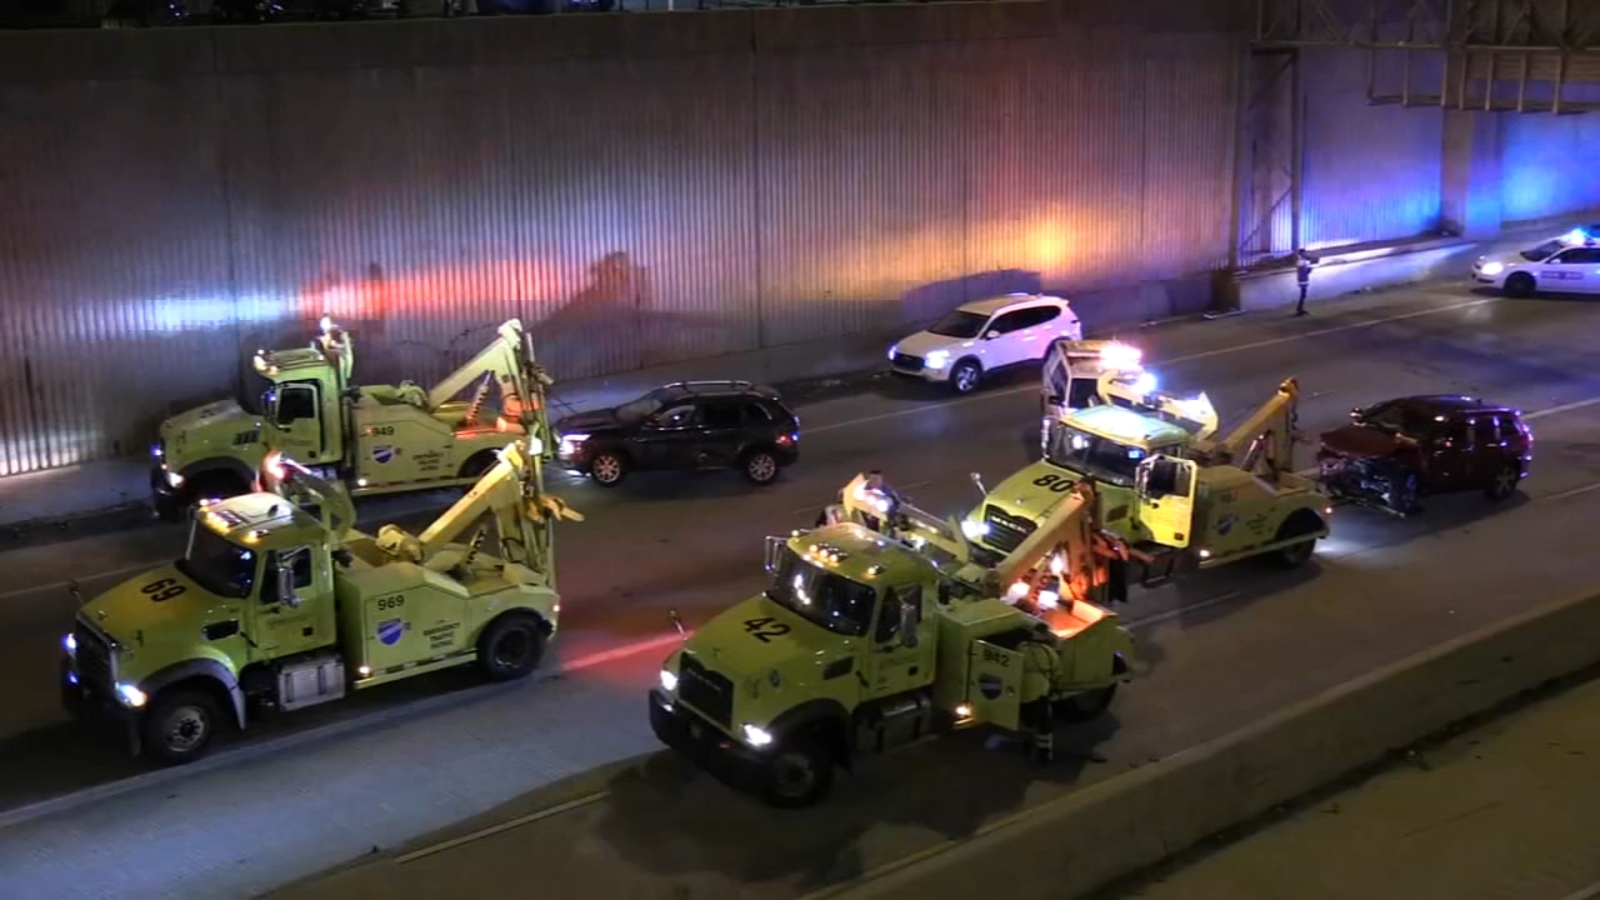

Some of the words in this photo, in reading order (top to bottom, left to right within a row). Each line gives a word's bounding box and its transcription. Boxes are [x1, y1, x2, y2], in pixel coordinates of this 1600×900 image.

[1033, 474, 1075, 492] 80
[140, 578, 187, 602] 69
[377, 594, 405, 611] 969
[743, 616, 791, 643] 42
